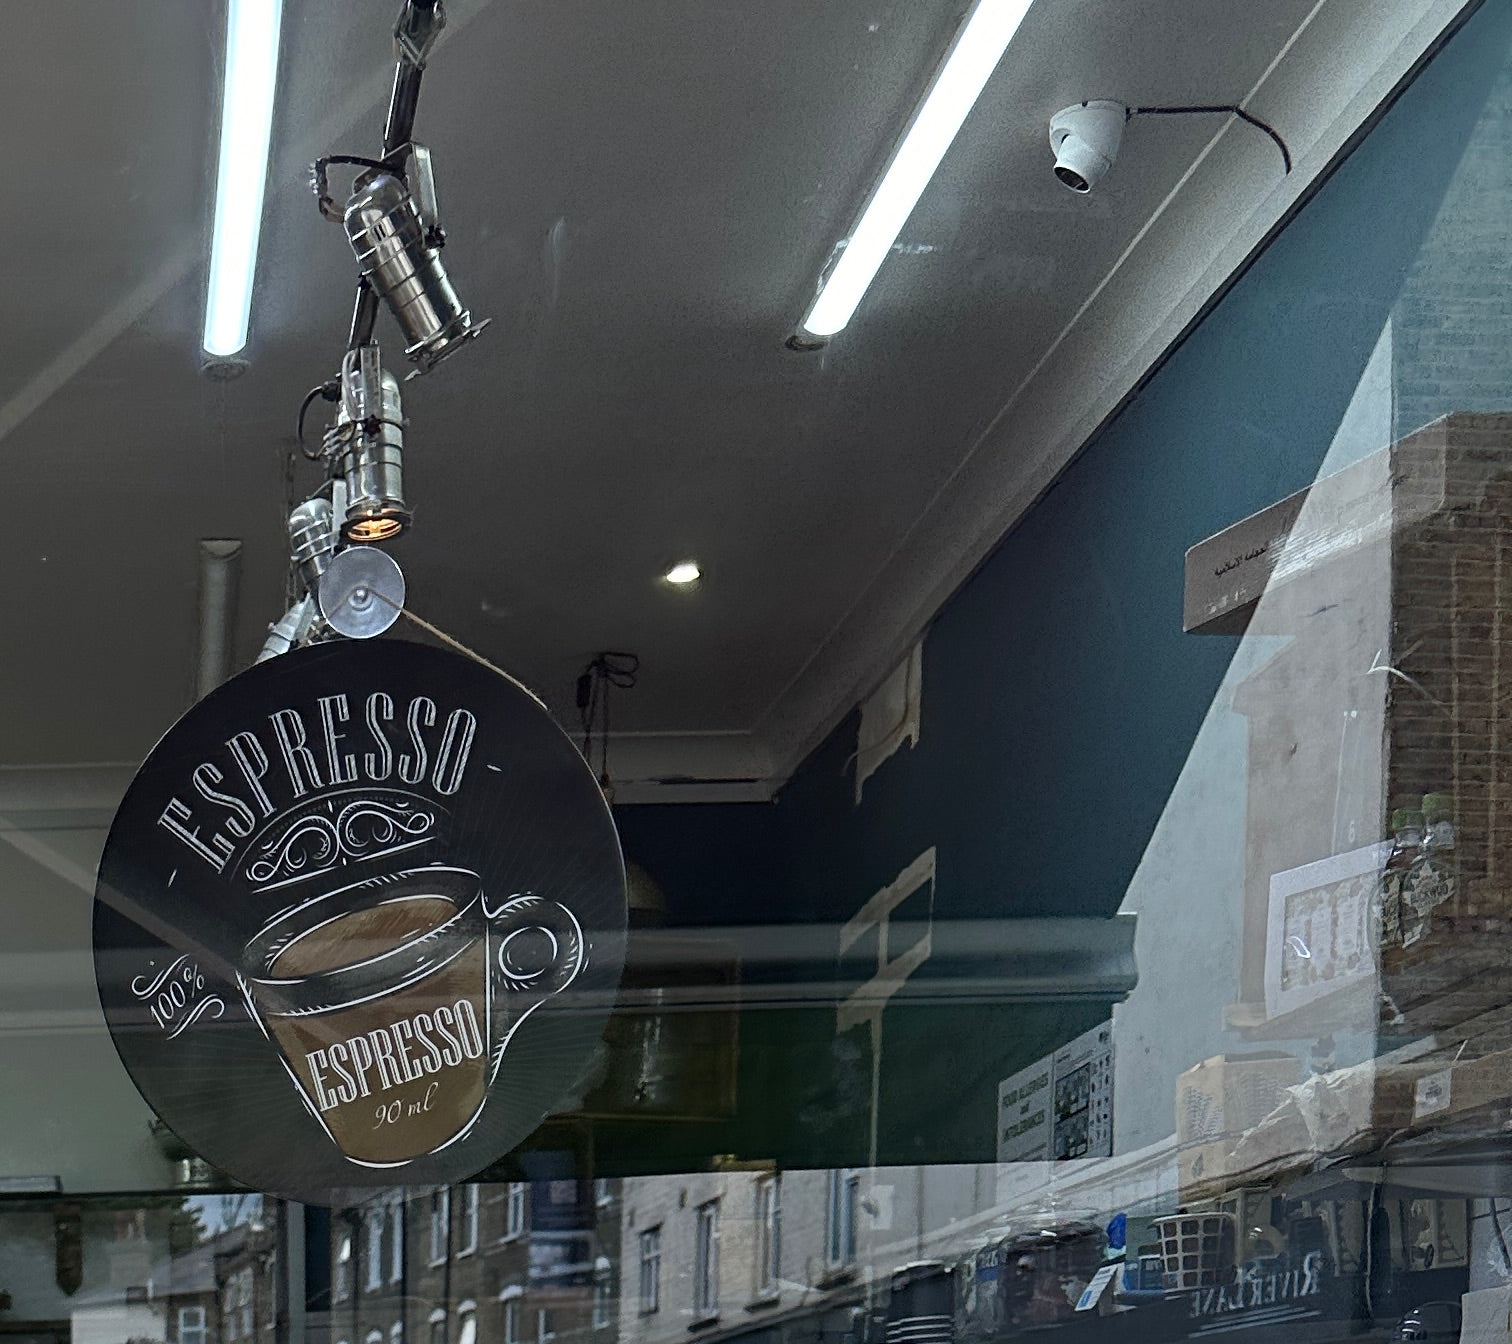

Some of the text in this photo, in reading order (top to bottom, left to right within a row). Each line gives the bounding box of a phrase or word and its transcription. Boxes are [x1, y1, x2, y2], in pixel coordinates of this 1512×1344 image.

[157, 693, 477, 874] ESPRESSO
[148, 964, 205, 1032] 100%
[305, 999, 484, 1113] ESPRESSO
[371, 1082, 439, 1130] 90 ml
